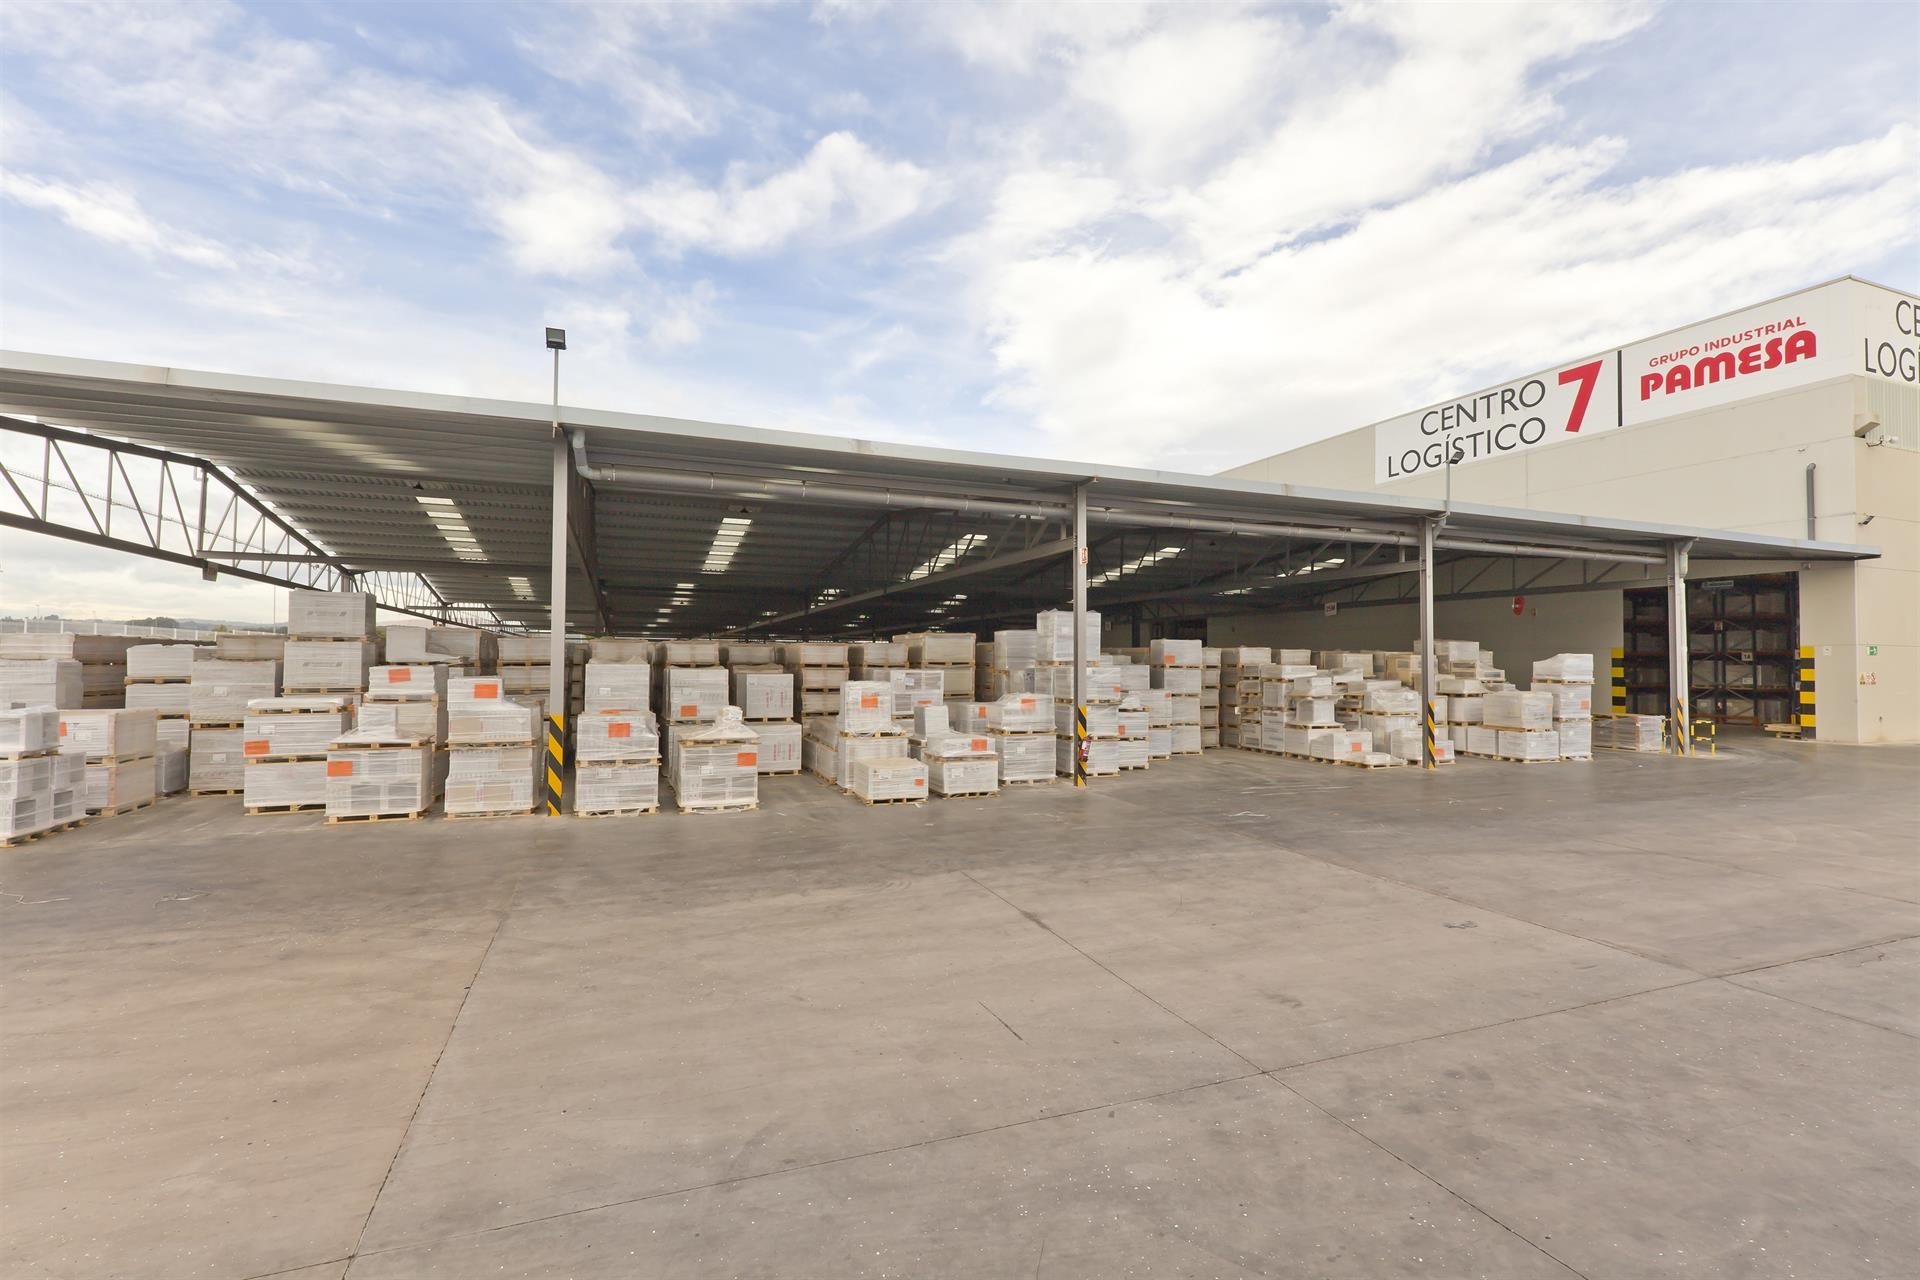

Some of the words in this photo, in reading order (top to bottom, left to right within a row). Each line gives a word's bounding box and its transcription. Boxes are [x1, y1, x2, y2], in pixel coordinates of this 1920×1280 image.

[1640, 330, 1817, 401] PAMESA
[1648, 346, 1700, 368] GRUPO
[1704, 316, 1807, 353] INDUSTRIAL
[1420, 379, 1546, 436] CENTRO
[1558, 360, 1603, 433] 7
